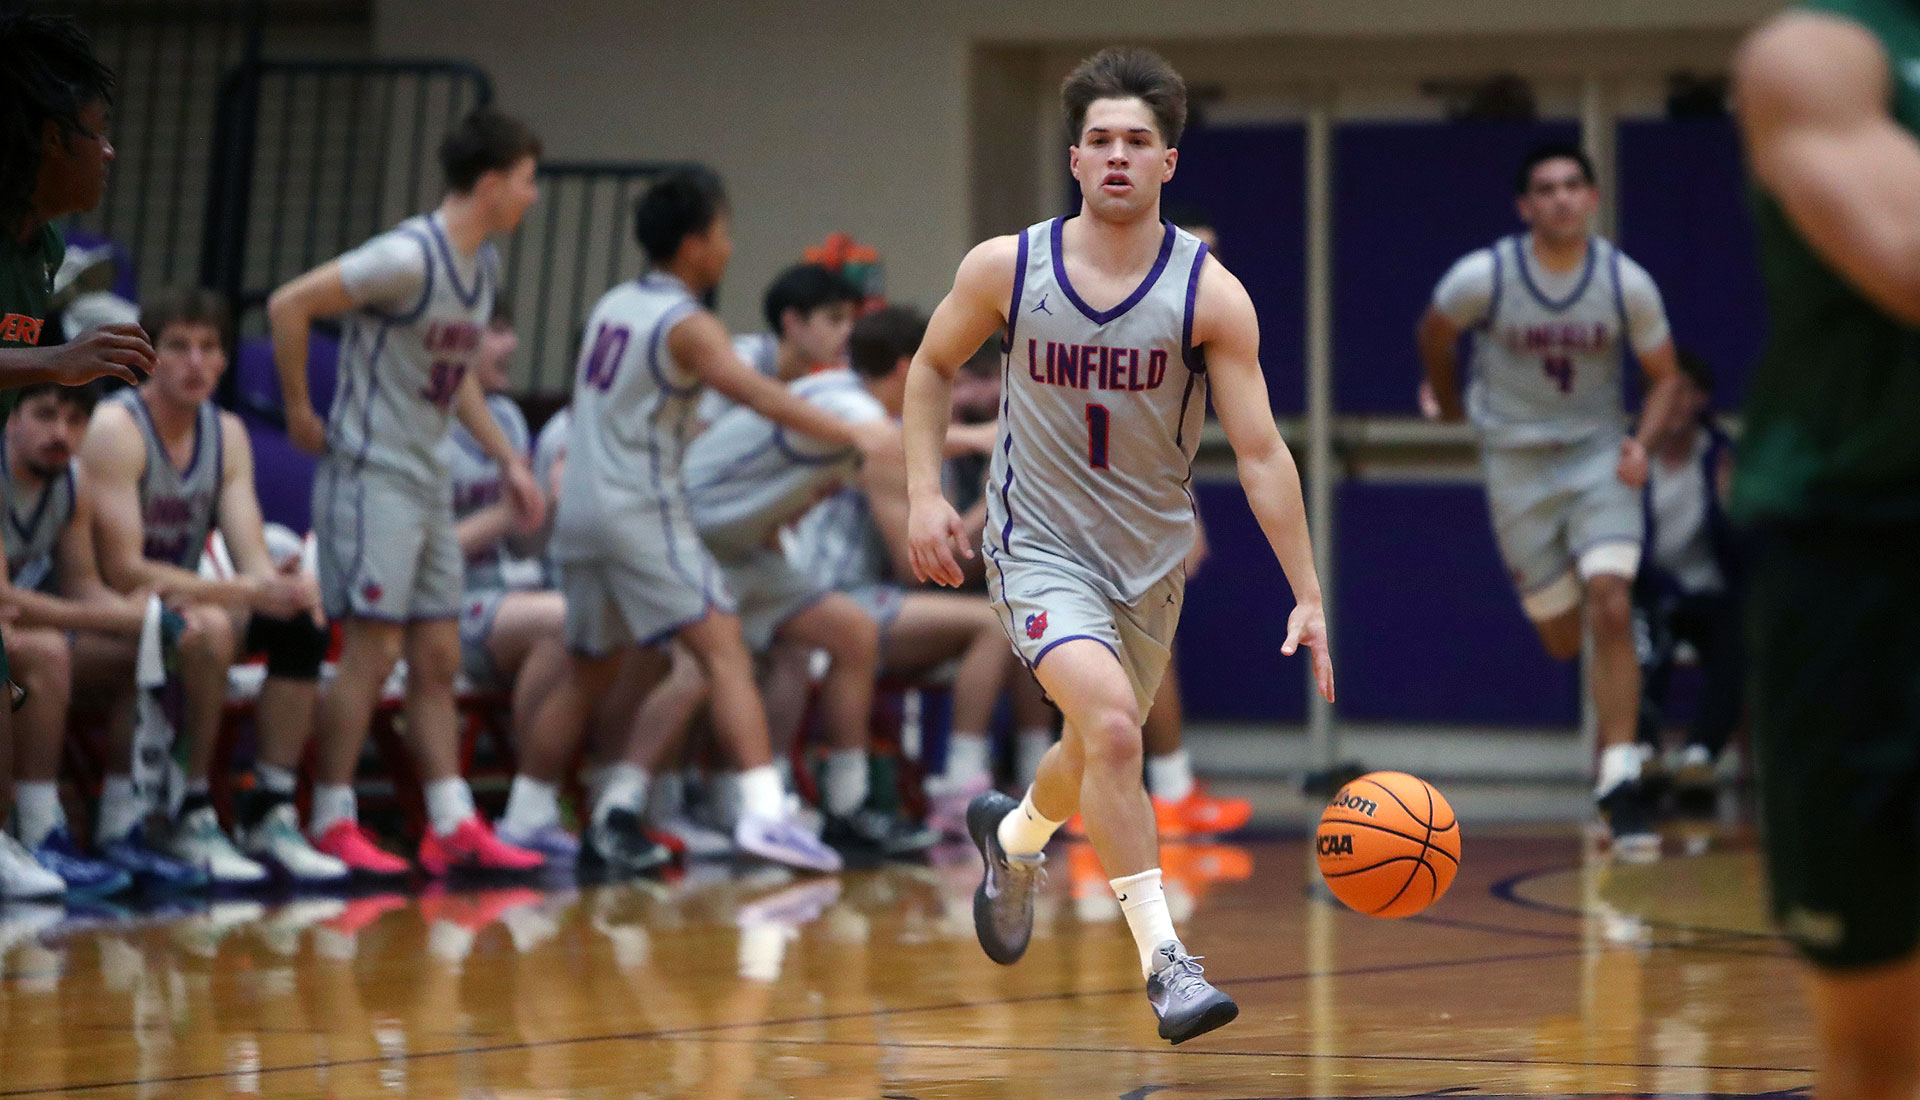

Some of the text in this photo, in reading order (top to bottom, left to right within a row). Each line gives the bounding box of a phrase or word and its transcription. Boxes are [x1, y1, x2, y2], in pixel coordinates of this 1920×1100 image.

[1028, 338, 1168, 392] LINFIELD
[1543, 357, 1573, 393] 4
[1085, 403, 1110, 470] 1
